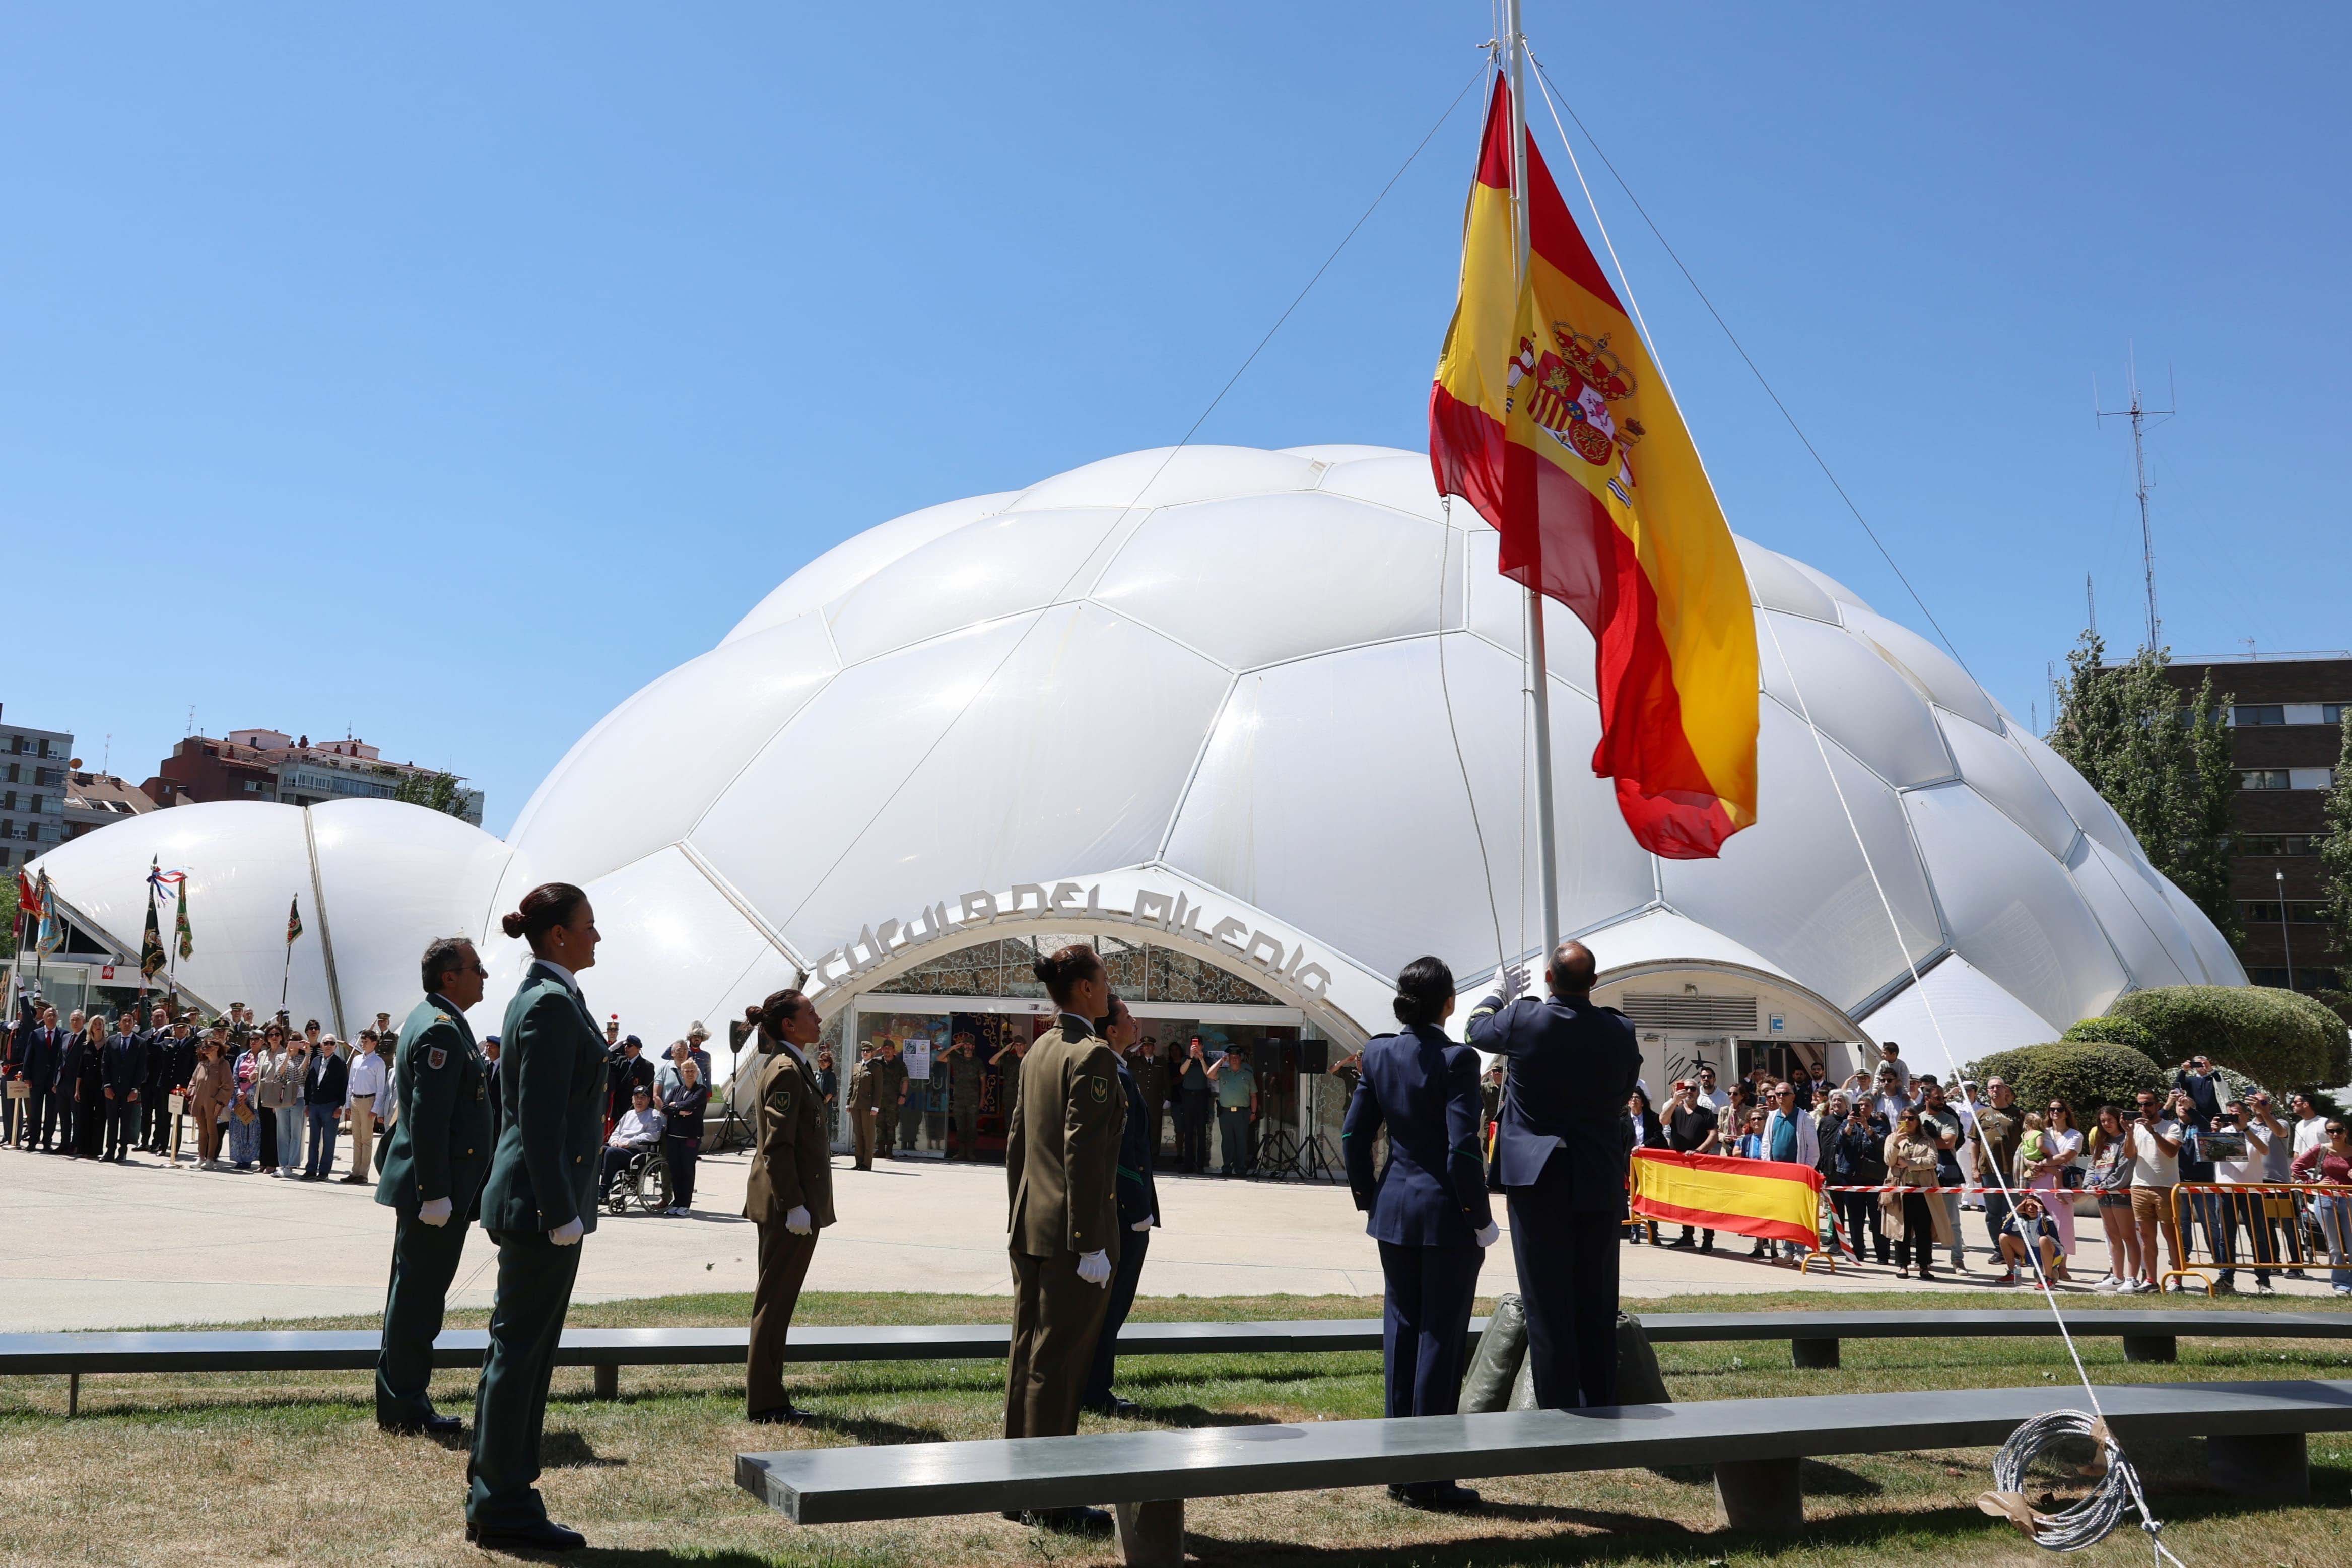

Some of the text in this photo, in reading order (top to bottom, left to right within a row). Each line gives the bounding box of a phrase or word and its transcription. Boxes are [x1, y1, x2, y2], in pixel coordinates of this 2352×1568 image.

[103, 967, 113, 978] illy
[1011, 883, 1111, 919] DEL
[1132, 889, 1331, 1002] MILENIO
